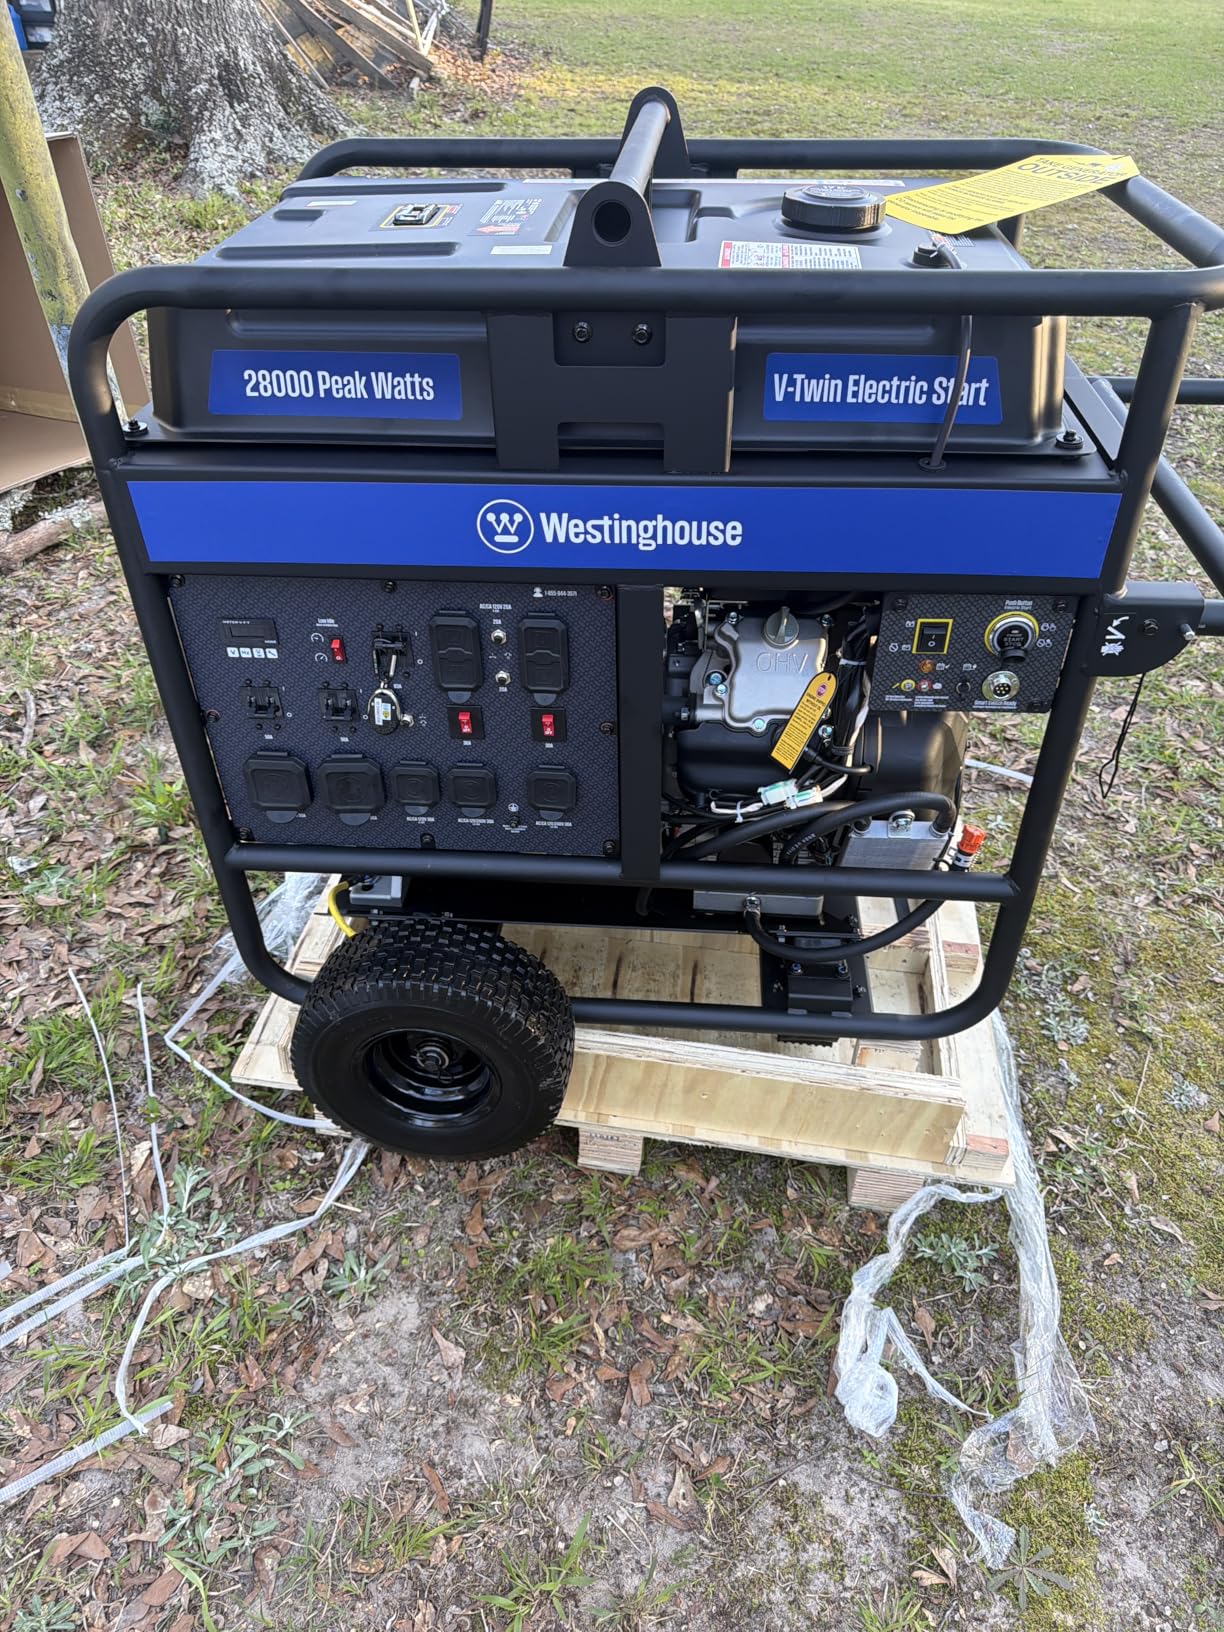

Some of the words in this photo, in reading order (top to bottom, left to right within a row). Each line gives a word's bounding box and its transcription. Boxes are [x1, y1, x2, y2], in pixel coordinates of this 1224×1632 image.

[1017, 162, 1117, 185] OUTSIDE
[243, 369, 314, 398] 28000
[317, 370, 369, 399] Peak
[370, 371, 435, 401] Watts
[773, 373, 843, 403] V-Twin
[846, 374, 928, 405] Electric
[932, 376, 989, 406] Start
[539, 512, 743, 551] Westinghouse
[756, 651, 809, 673] OHV
